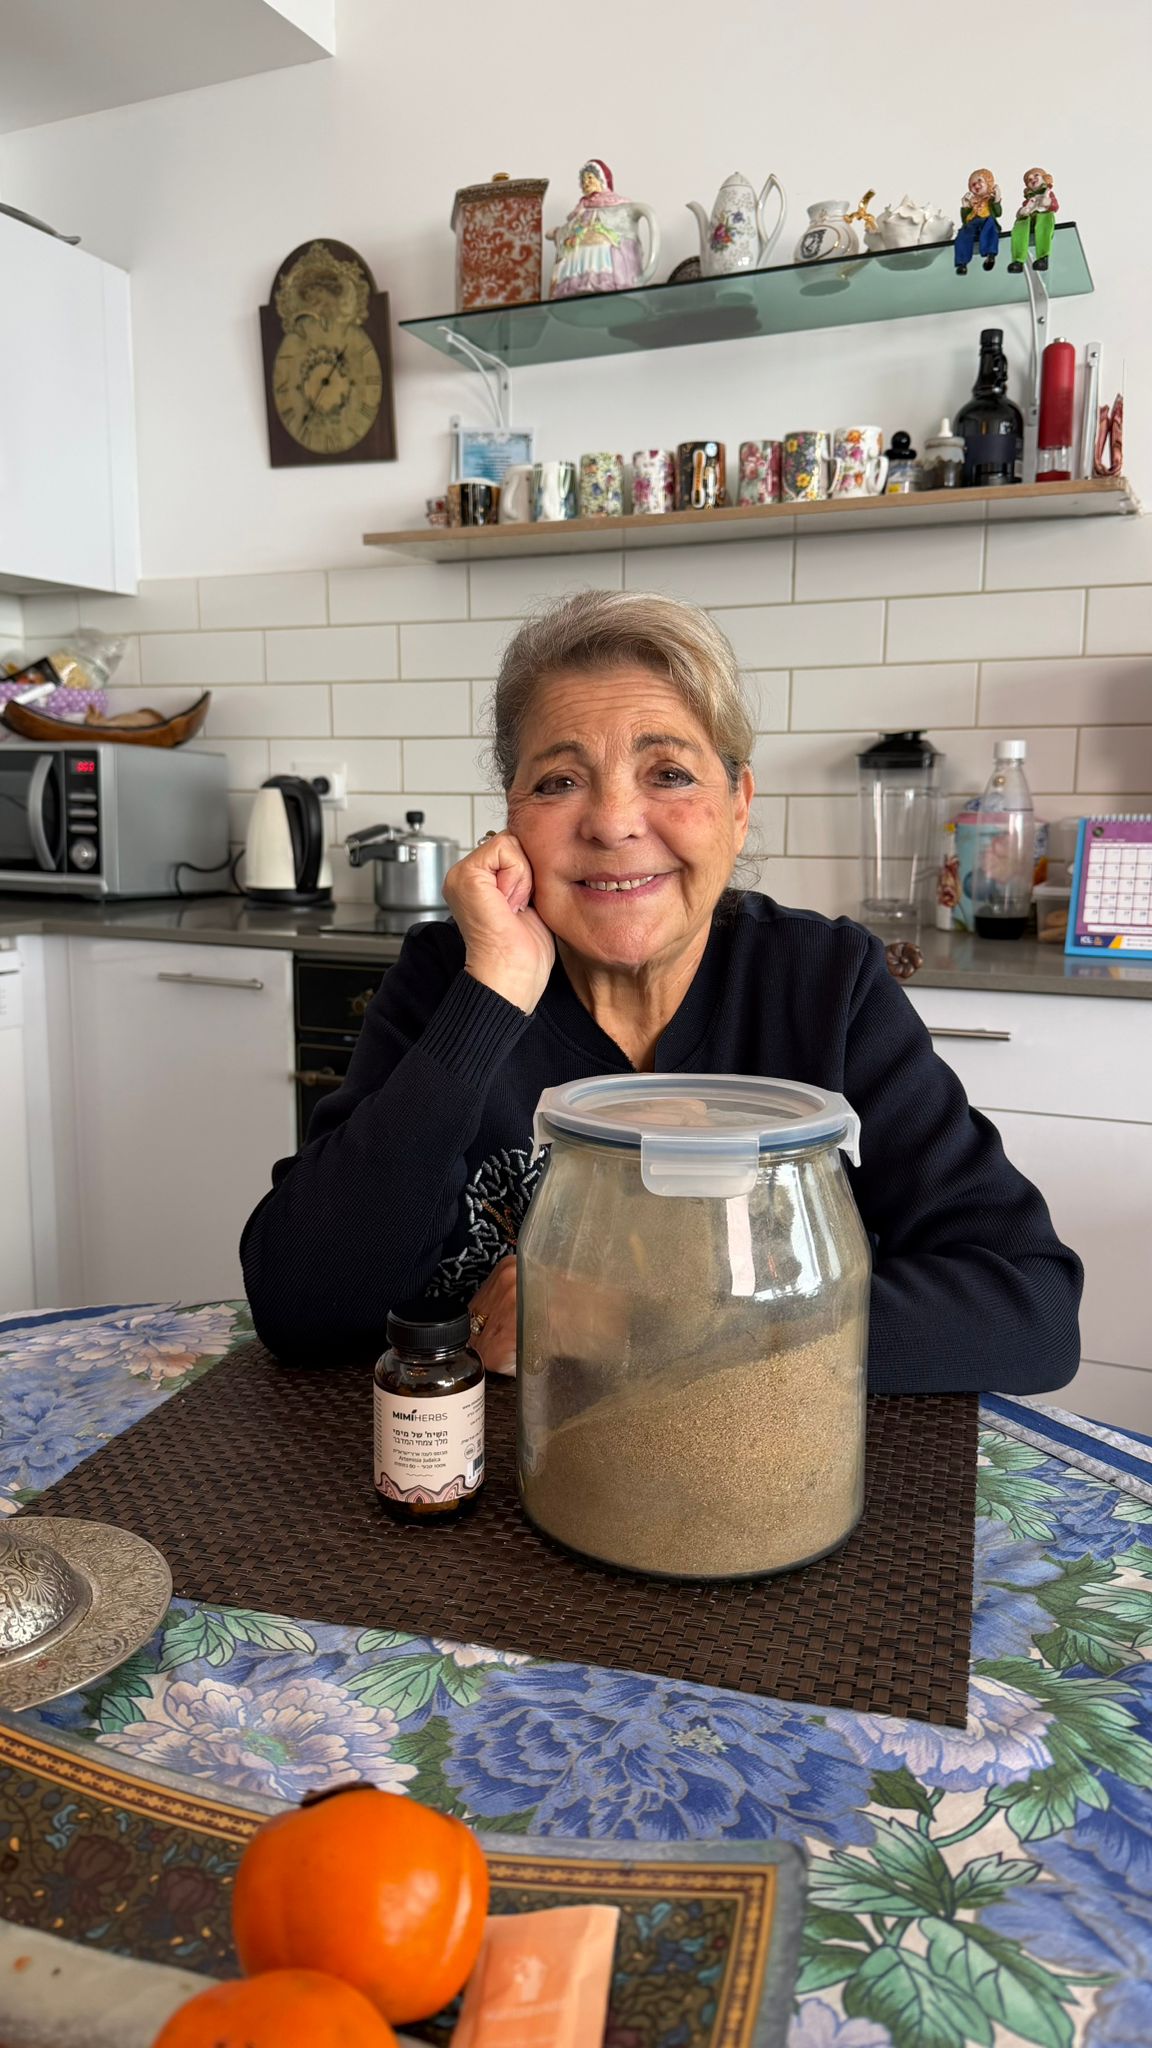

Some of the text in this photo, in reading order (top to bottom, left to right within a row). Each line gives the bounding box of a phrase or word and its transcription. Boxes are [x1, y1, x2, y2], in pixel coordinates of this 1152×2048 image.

[393, 1428, 409, 1437] מימי
[393, 1436, 414, 1445] המדבר
[434, 1438, 448, 1447] מלך
